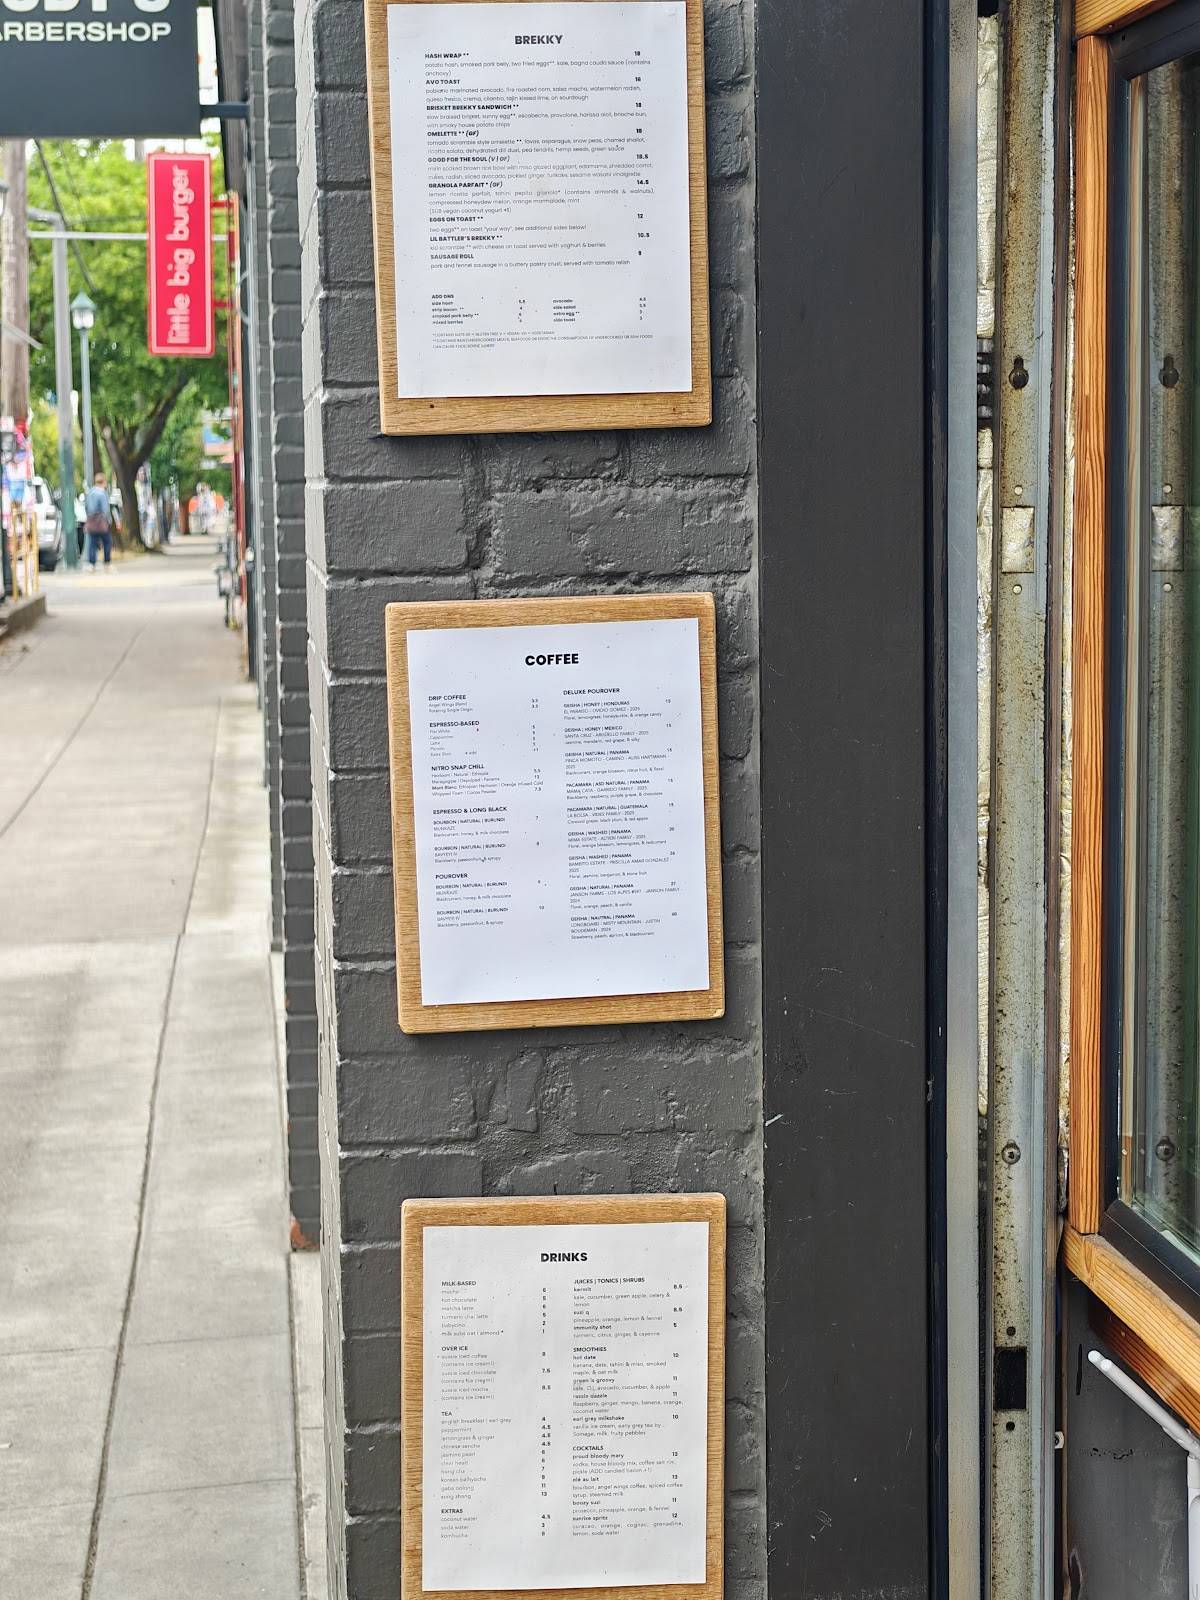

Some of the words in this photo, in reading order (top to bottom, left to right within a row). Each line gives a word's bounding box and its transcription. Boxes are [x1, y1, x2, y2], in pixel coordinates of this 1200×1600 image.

[0, 21, 172, 42] RBERSHOP
[514, 35, 563, 45] BREKKY
[477, 139, 490, 147] style
[165, 164, 195, 241] burger
[166, 248, 195, 286] big
[525, 653, 579, 666] COFFEE
[429, 720, 480, 728] ESPRESSO-BASED
[540, 1252, 588, 1262] DRINKS
